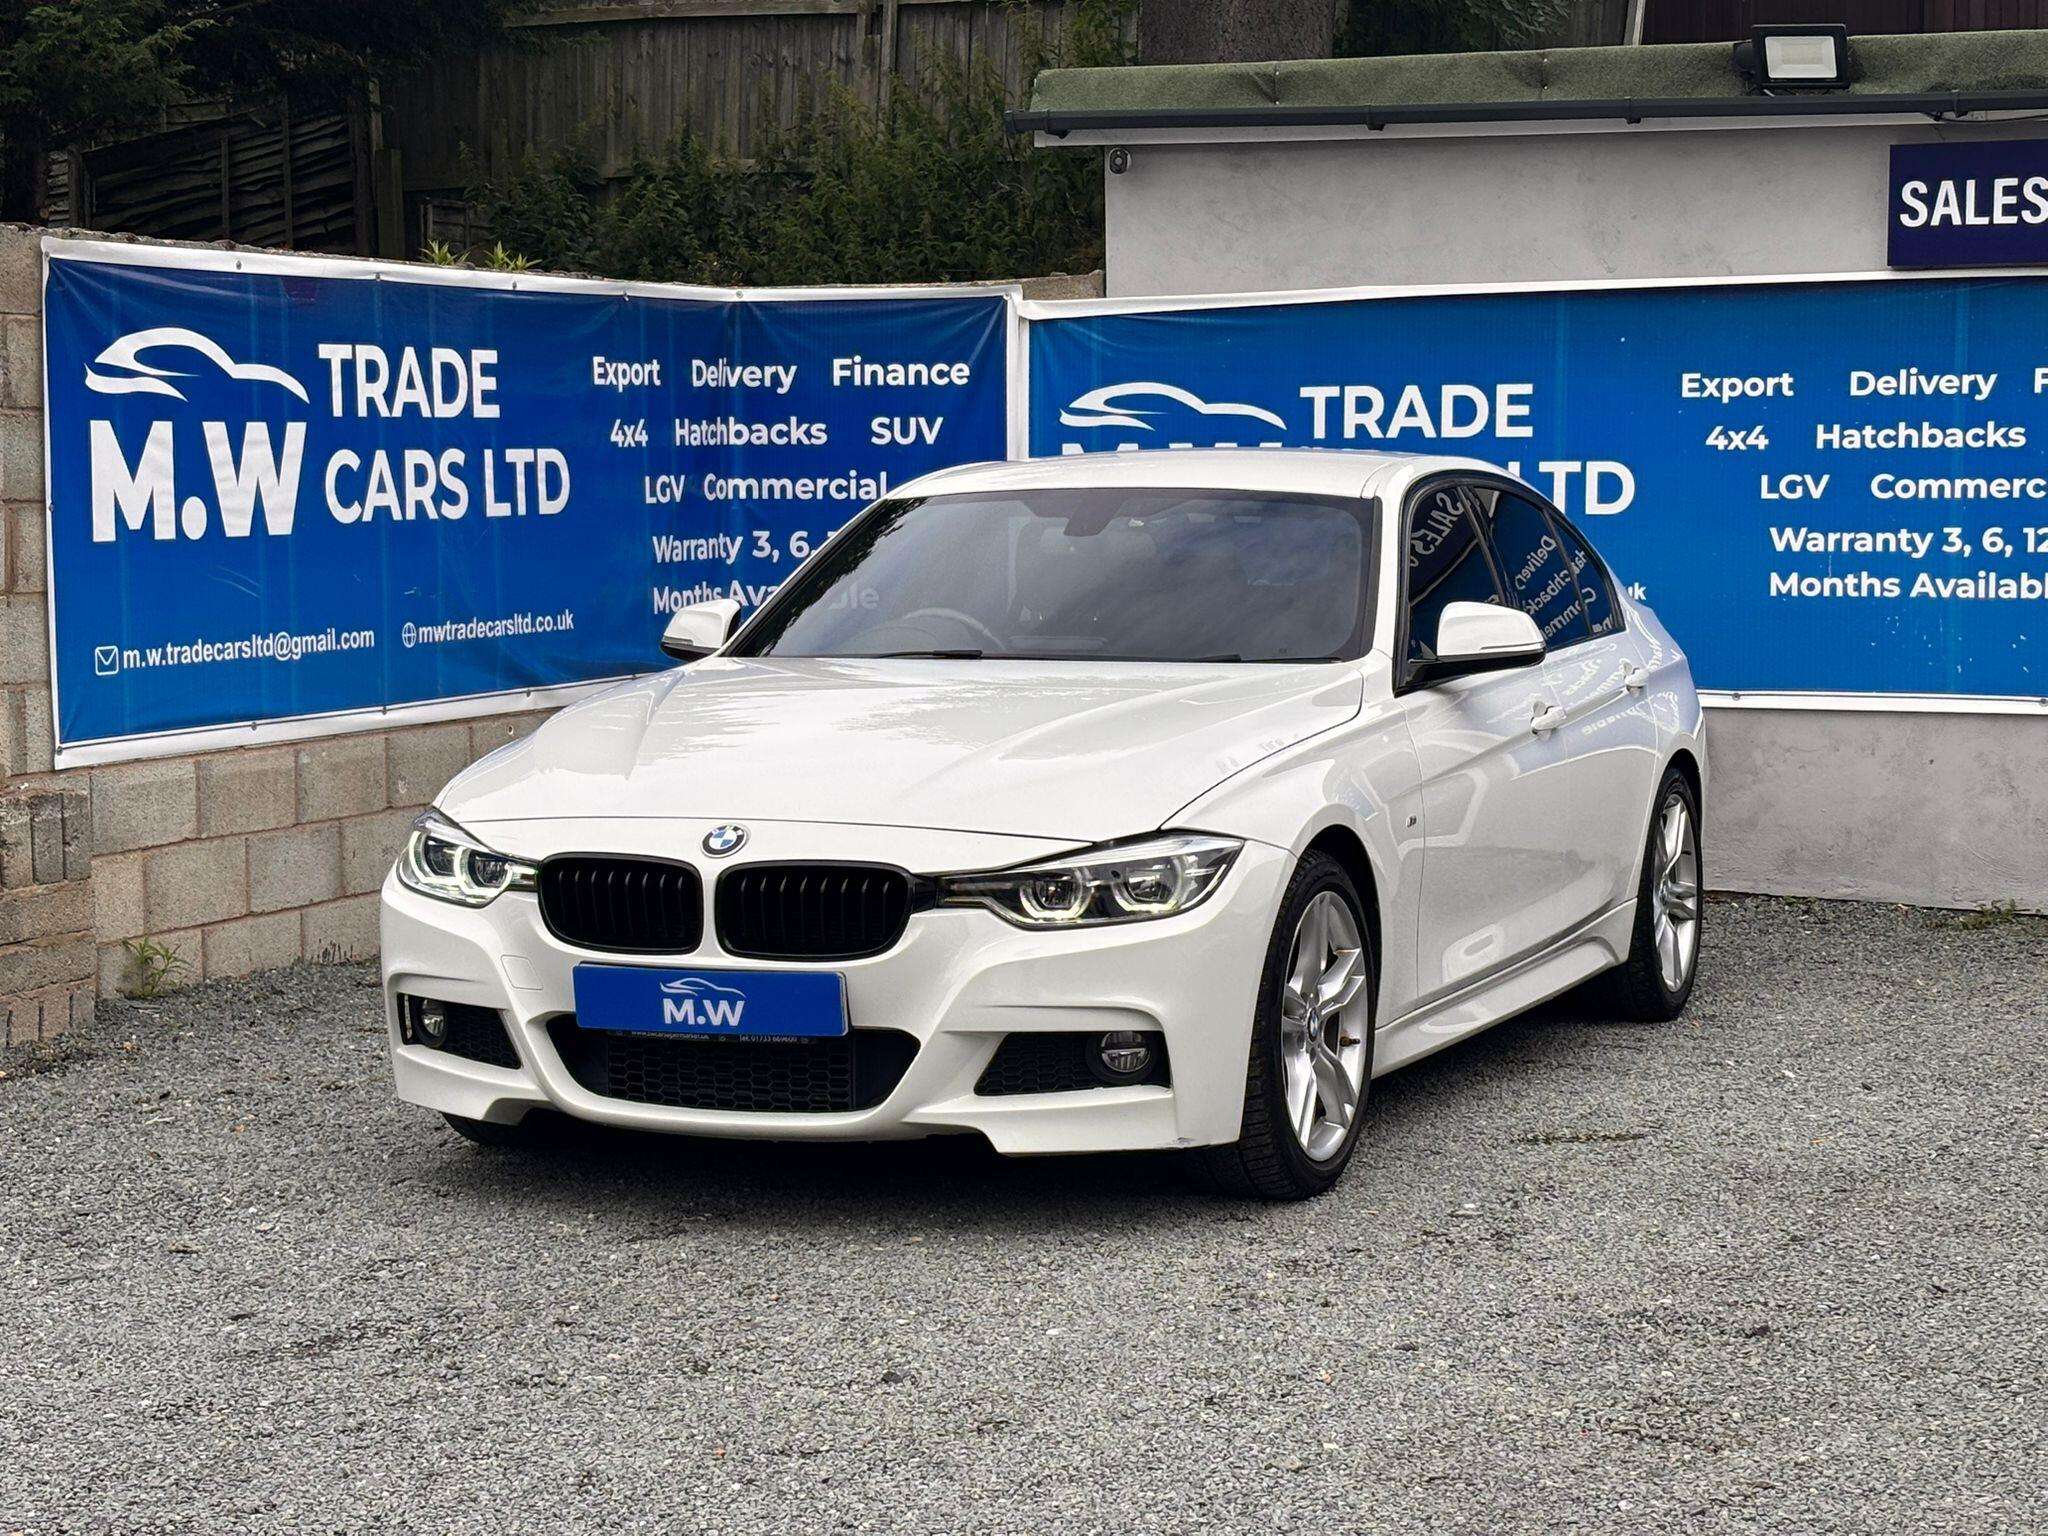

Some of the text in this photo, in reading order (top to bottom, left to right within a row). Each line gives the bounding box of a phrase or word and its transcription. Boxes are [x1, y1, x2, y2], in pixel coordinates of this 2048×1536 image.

[1900, 177, 2048, 227] SALES
[319, 344, 500, 418] TRADE
[593, 355, 970, 394] Export Delivery Finance
[1682, 373, 1793, 403] Export
[1851, 367, 1997, 400] Delivery
[1300, 384, 1533, 439] TRADE
[611, 416, 943, 447] 4x4 Hatchbacks SUV
[1706, 421, 2026, 450] 4x4 Hatchbacks
[90, 420, 306, 542] M.W
[325, 448, 570, 523] CARS LTD
[645, 469, 887, 503] LGV Commercial
[1761, 474, 1829, 499] LGV
[653, 534, 743, 564] Warranty
[753, 531, 779, 562] 3,
[1770, 527, 1933, 558] Warranty
[1942, 528, 1971, 557] 3,
[1982, 527, 2012, 557] 6,
[1770, 571, 1900, 597] Months
[419, 610, 573, 643] mwtradecarsltd.co.uk
[124, 628, 374, 668] m.w.tradecarsltd@gmail.com
[663, 999, 744, 1026] M.W
